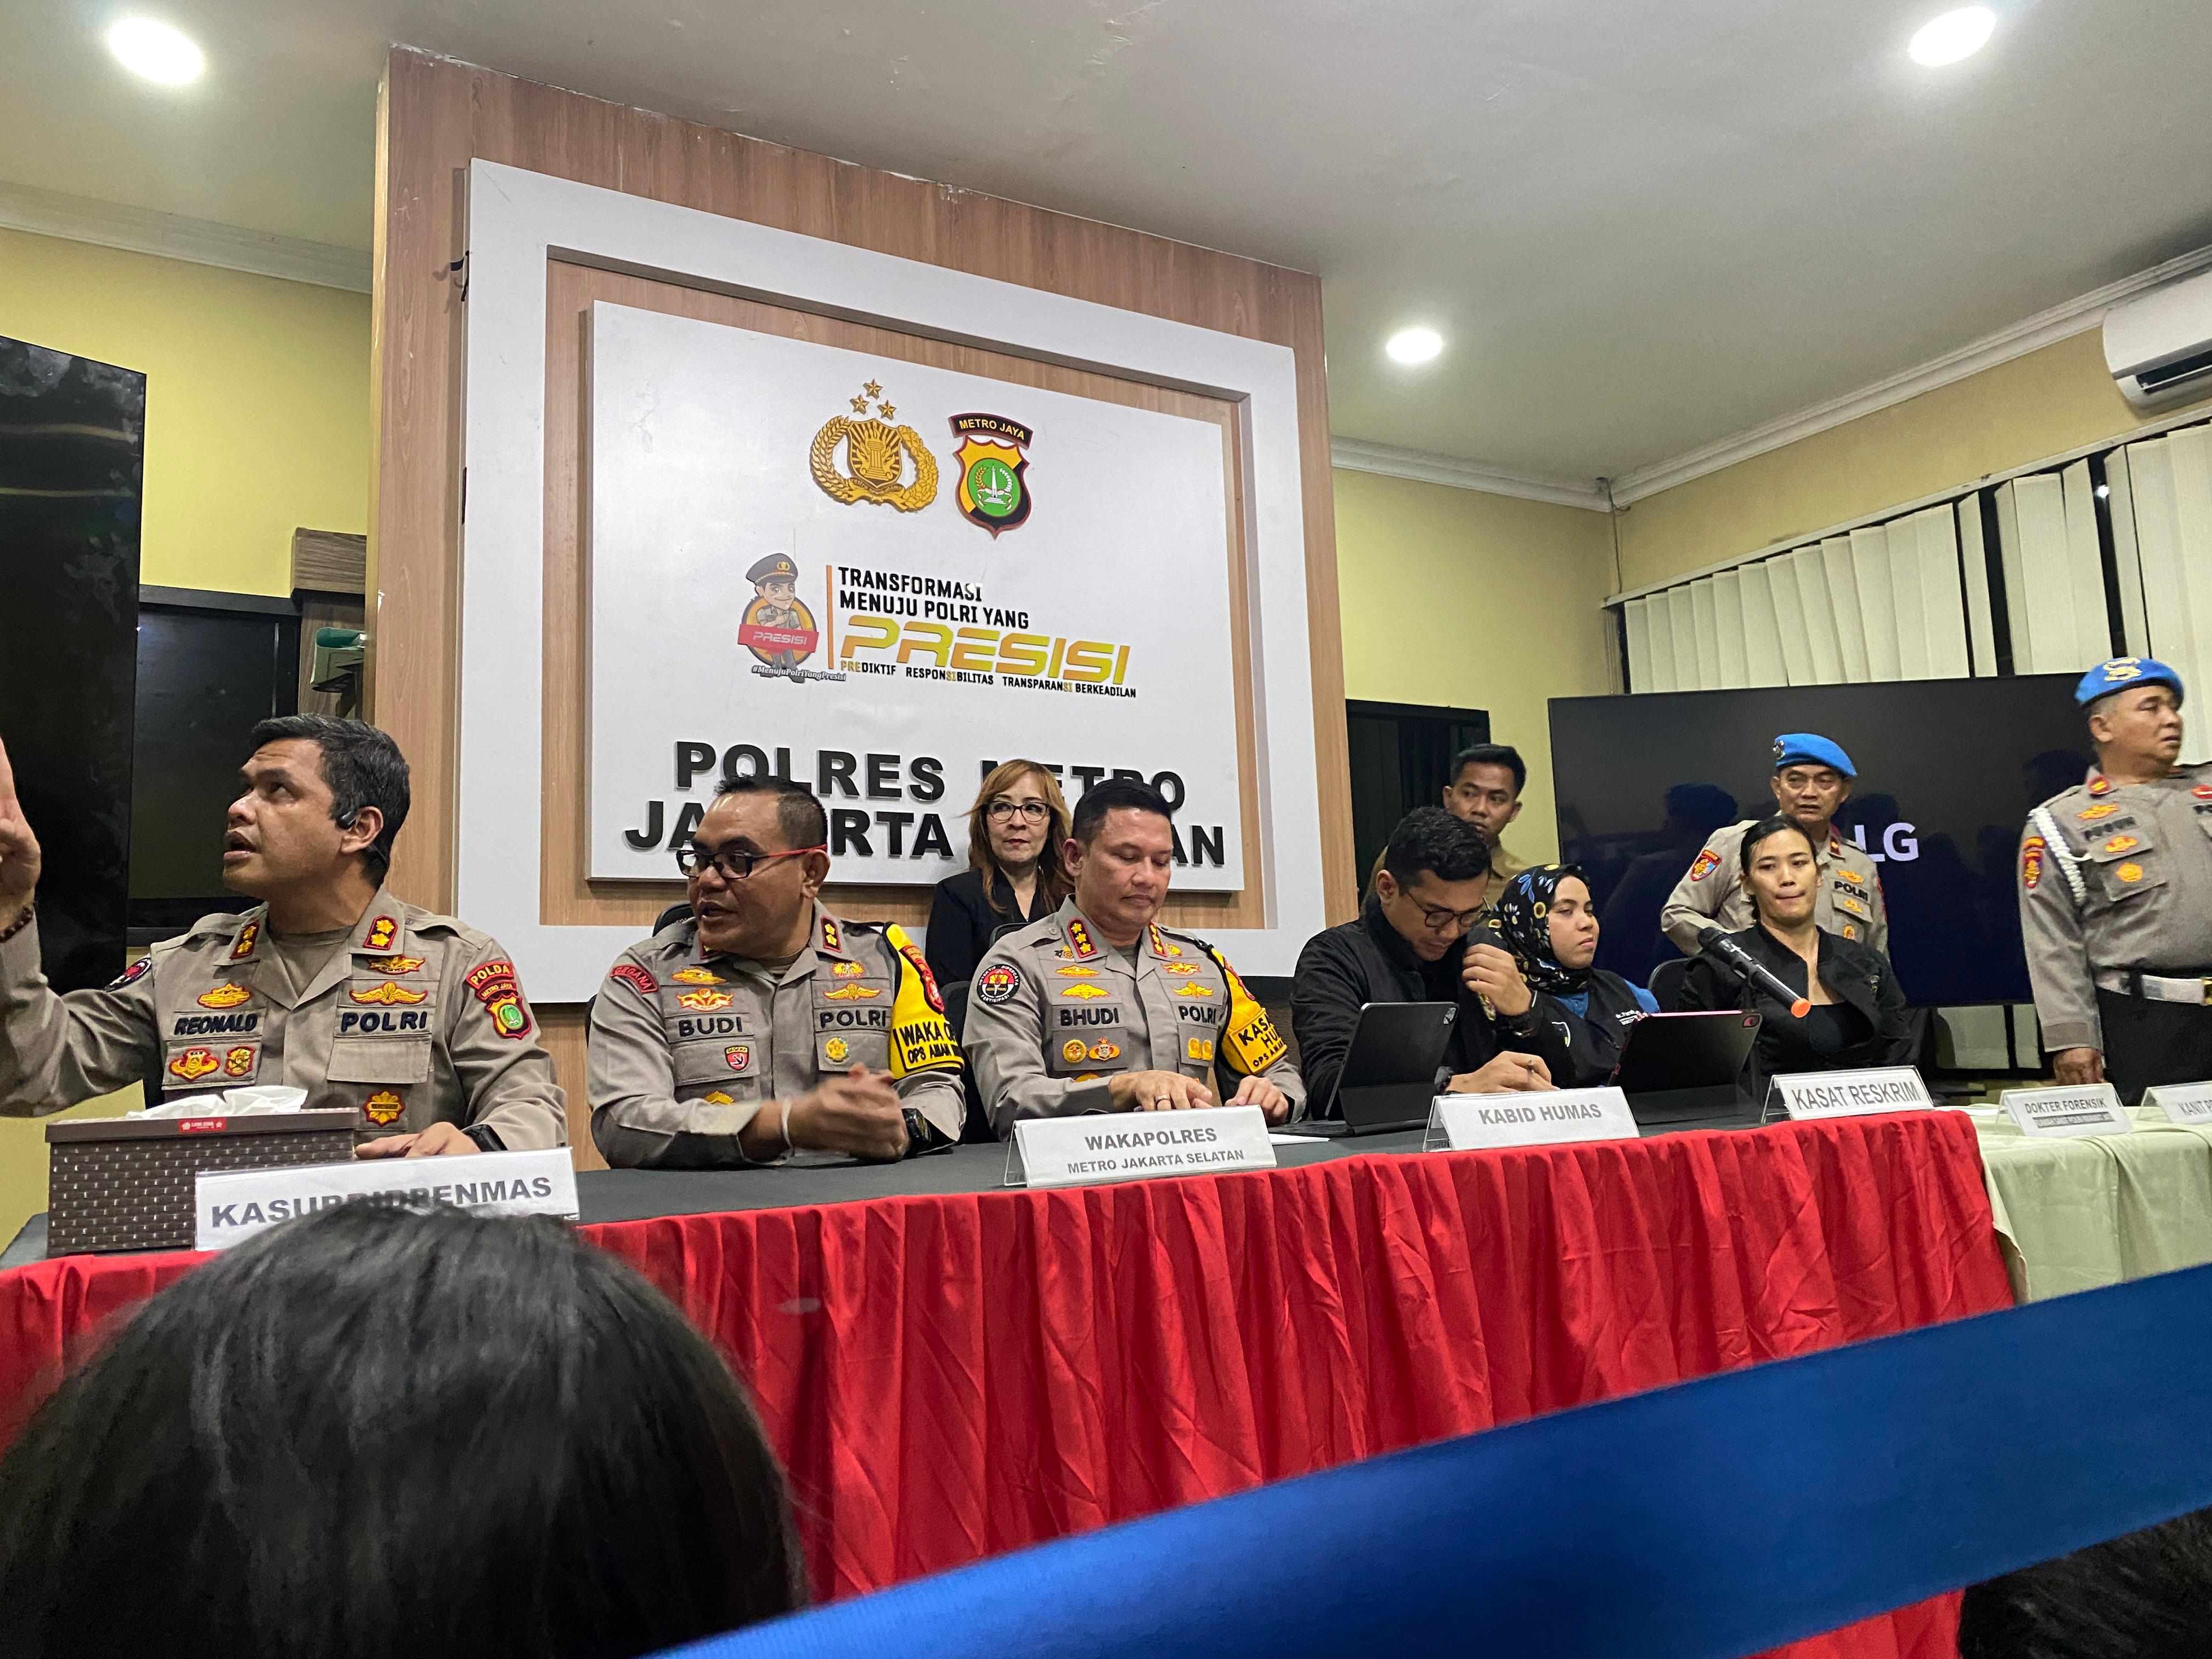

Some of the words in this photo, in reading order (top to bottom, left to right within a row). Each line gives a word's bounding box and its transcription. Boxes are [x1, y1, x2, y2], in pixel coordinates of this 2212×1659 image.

[959, 419, 997, 430] METRO
[1000, 423, 1024, 440] JAYA
[838, 567, 983, 602] TRANSFORMASI
[840, 590, 917, 616] MENUJU
[924, 600, 978, 623] POLRI
[983, 607, 1029, 629] YANG
[753, 631, 807, 645] PRESISI
[840, 614, 1130, 685] PRESISI
[752, 665, 847, 681] #MenujuPolriYangPresisi
[841, 661, 896, 675] PREDIKTIF
[906, 667, 994, 685] RESPONSIBILITAS
[1002, 676, 1073, 692] TRANSPARANSI
[1075, 682, 1136, 698] BERKEADILAN
[675, 741, 945, 801] POLRES
[625, 800, 954, 857] JARTA
[470, 964, 510, 985] POLDA
[341, 1011, 427, 1032] POLRI
[820, 1009, 886, 1029] POLRI
[1060, 1007, 1119, 1026] BHUDI
[1178, 1005, 1216, 1025] POLRI
[679, 1017, 742, 1037] BUDI
[899, 1020, 943, 1047] WAKA
[907, 1046, 927, 1064] OPS
[1252, 1053, 1269, 1067] OPS
[1791, 1086, 1848, 1110] KASAT
[1848, 1081, 1922, 1105] RESKRIM
[2024, 1101, 2063, 1114] DOKTER
[2062, 1098, 2108, 1111] FORENSIK
[1479, 1107, 1536, 1125] KABID
[1539, 1104, 1602, 1121] HUMAS
[2178, 1101, 2207, 1116] KANIT
[1084, 1128, 1217, 1150] WAKAPOLRES
[1068, 1160, 1116, 1173] METRO
[1121, 1154, 1183, 1169] JAKARTA
[1187, 1149, 1244, 1163] SELATAN
